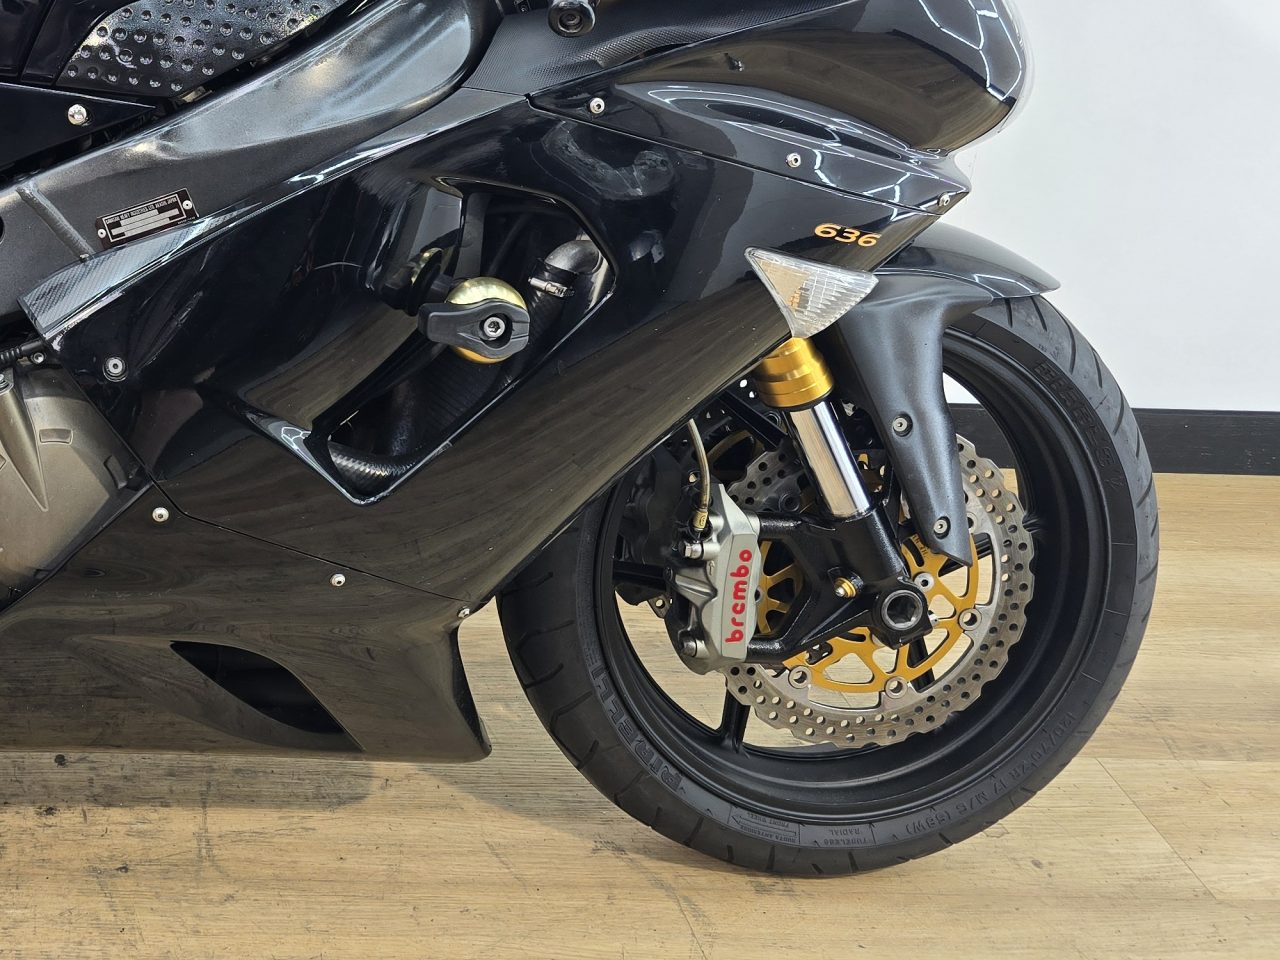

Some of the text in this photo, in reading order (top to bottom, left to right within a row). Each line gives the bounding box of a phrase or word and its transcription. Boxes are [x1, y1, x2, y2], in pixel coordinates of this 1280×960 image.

[814, 223, 882, 247] 636
[725, 549, 753, 643] brembo
[590, 663, 682, 794] PIRELLI
